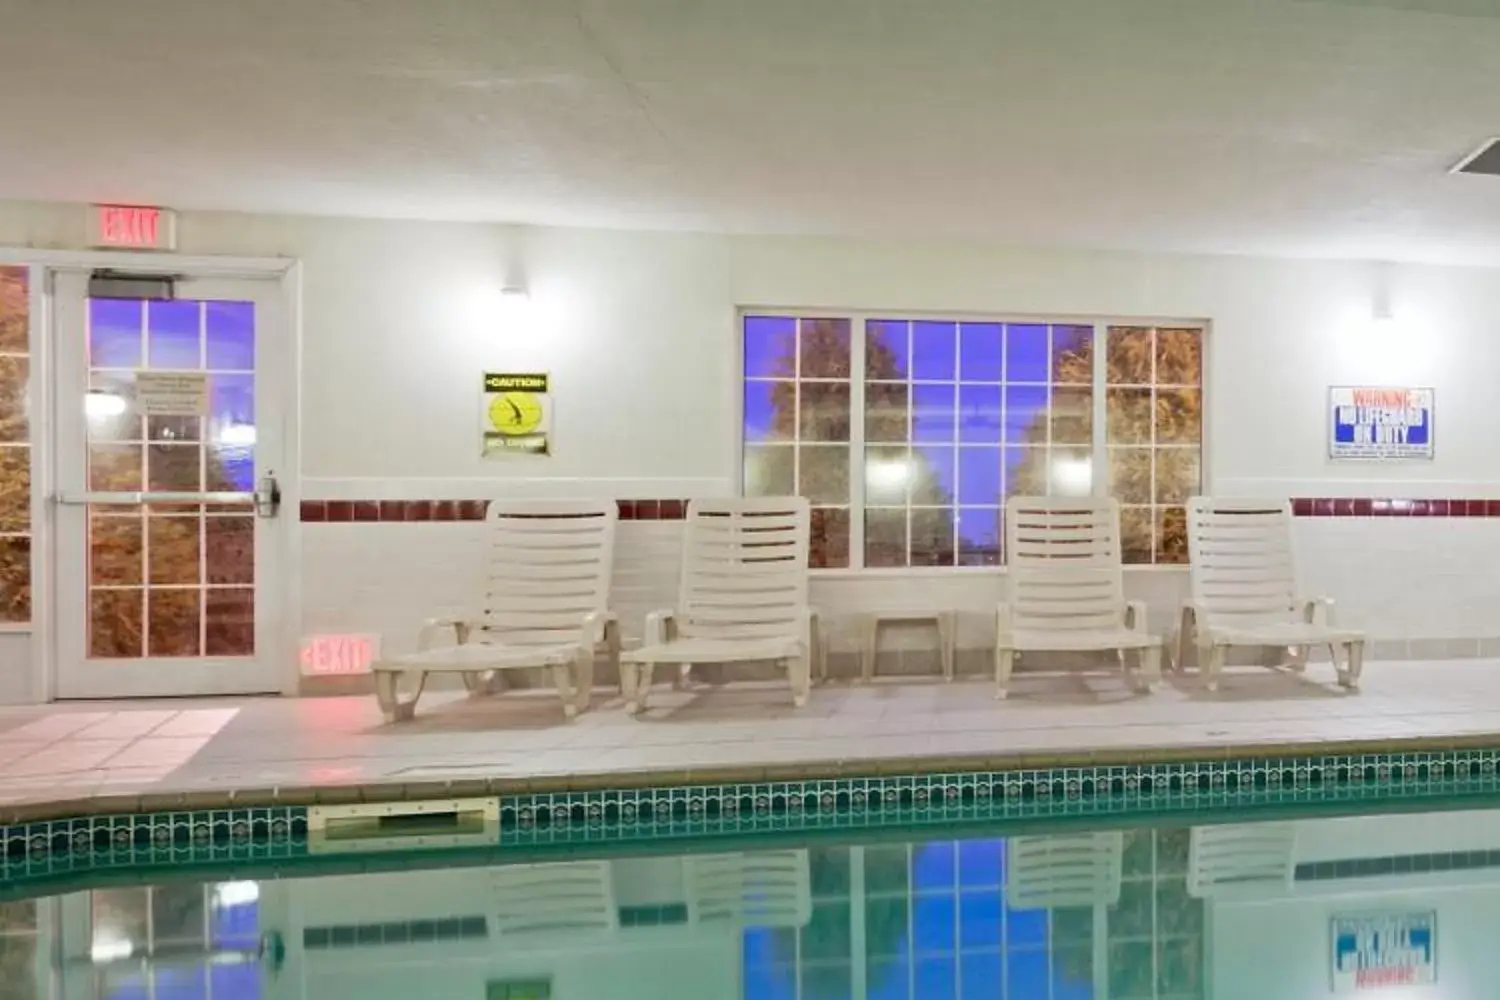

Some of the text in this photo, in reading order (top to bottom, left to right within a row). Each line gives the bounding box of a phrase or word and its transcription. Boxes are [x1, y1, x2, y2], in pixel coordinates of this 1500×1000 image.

[101, 206, 159, 244] EXIT
[491, 377, 542, 388] CAUTION
[1353, 388, 1416, 408] WARNING
[312, 637, 369, 672] EXIT
